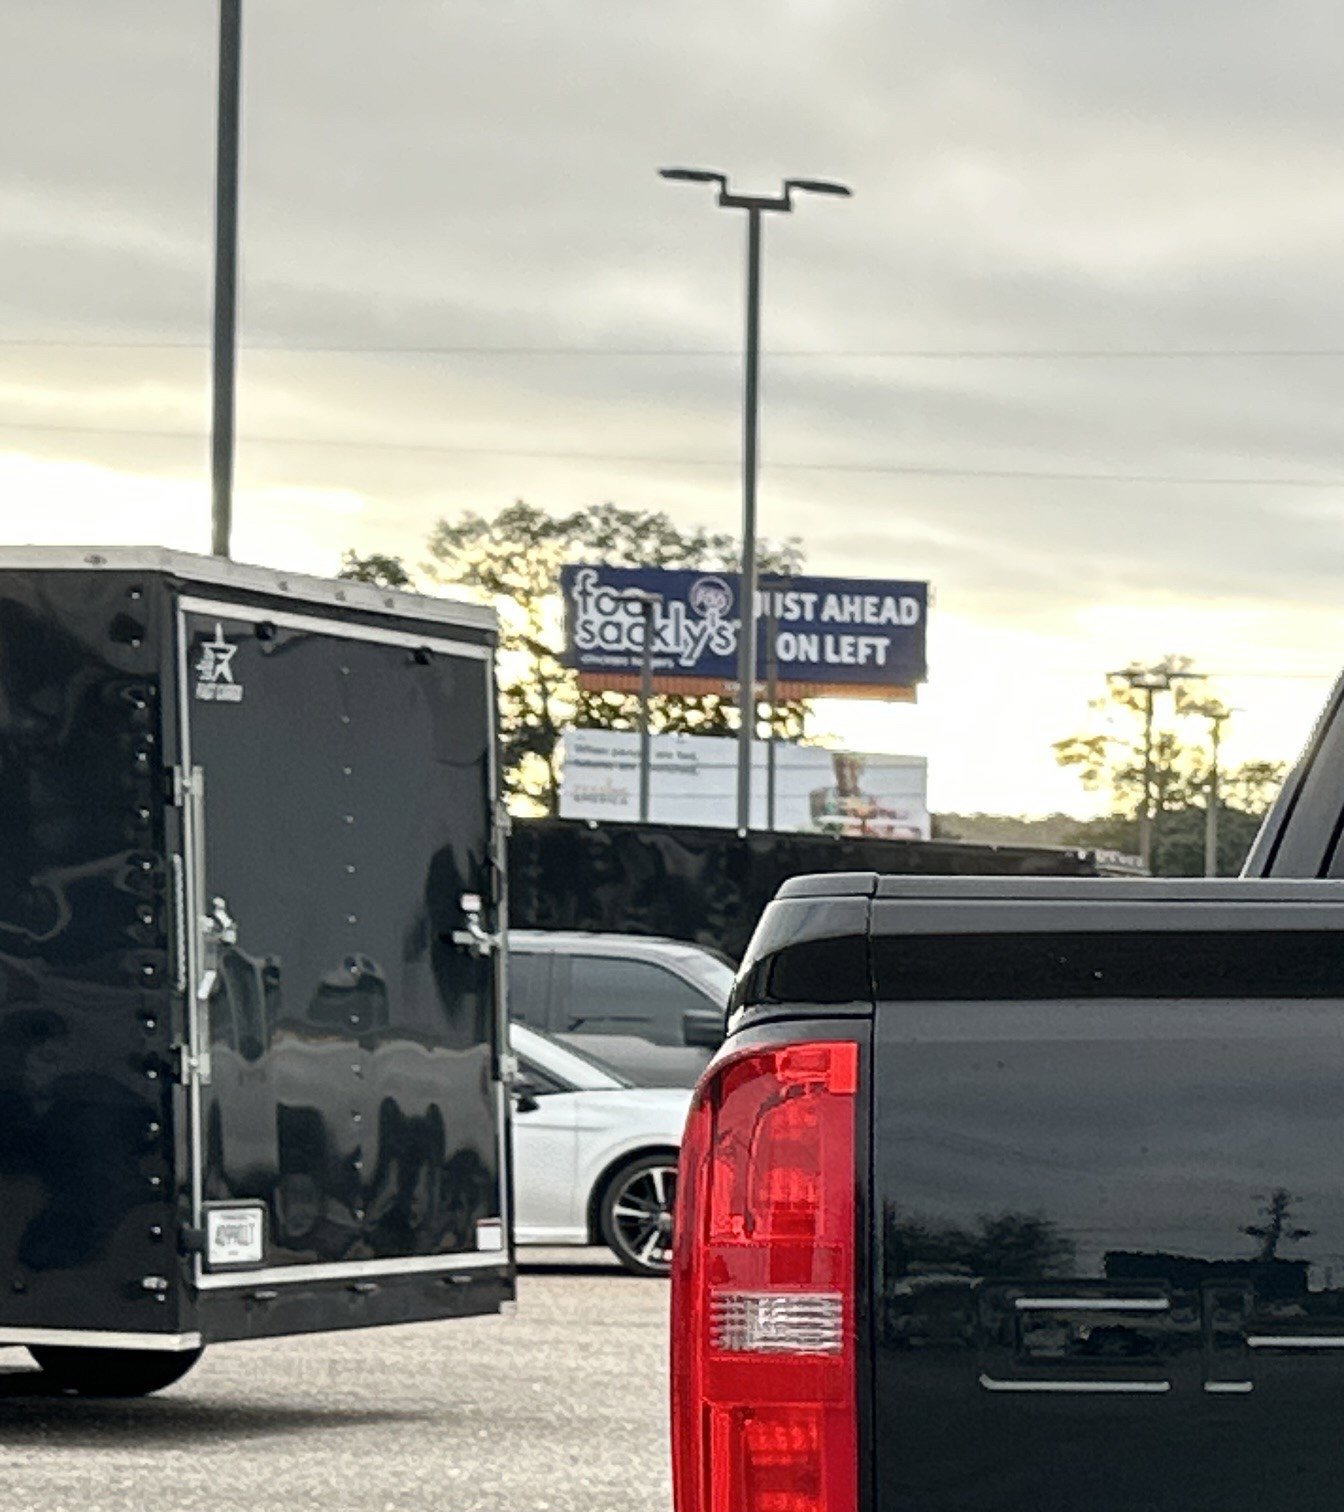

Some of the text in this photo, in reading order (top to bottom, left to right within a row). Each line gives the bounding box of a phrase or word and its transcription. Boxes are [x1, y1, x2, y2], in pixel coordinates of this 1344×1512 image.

[821, 594, 920, 626] AHEAD
[777, 632, 891, 666] ON LEFT
